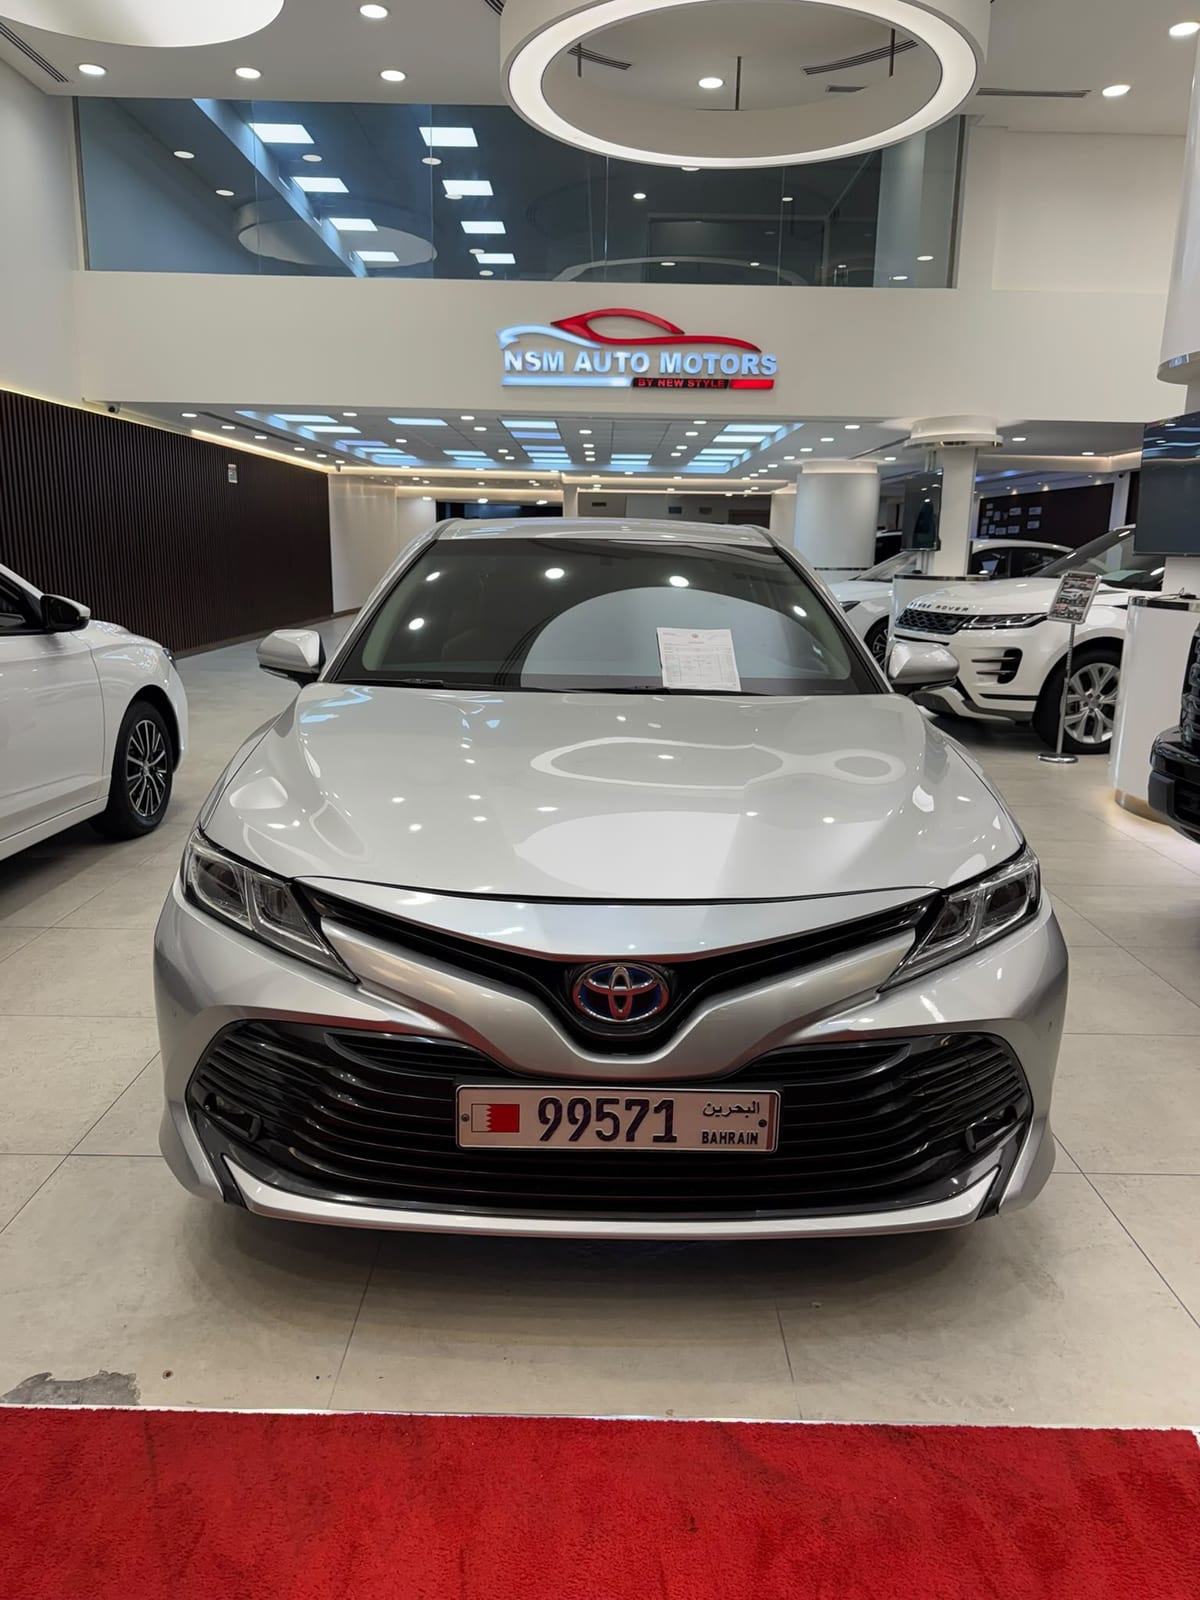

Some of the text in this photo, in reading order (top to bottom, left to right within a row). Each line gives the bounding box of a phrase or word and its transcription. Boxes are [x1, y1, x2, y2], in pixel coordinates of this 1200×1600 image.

[503, 350, 778, 376] NSM AUTO MOTORS
[638, 378, 725, 388] BY NEW STYLE
[702, 1101, 760, 1118] البحرين
[537, 1097, 678, 1144] 99571
[701, 1130, 759, 1146] BAHRAIN
